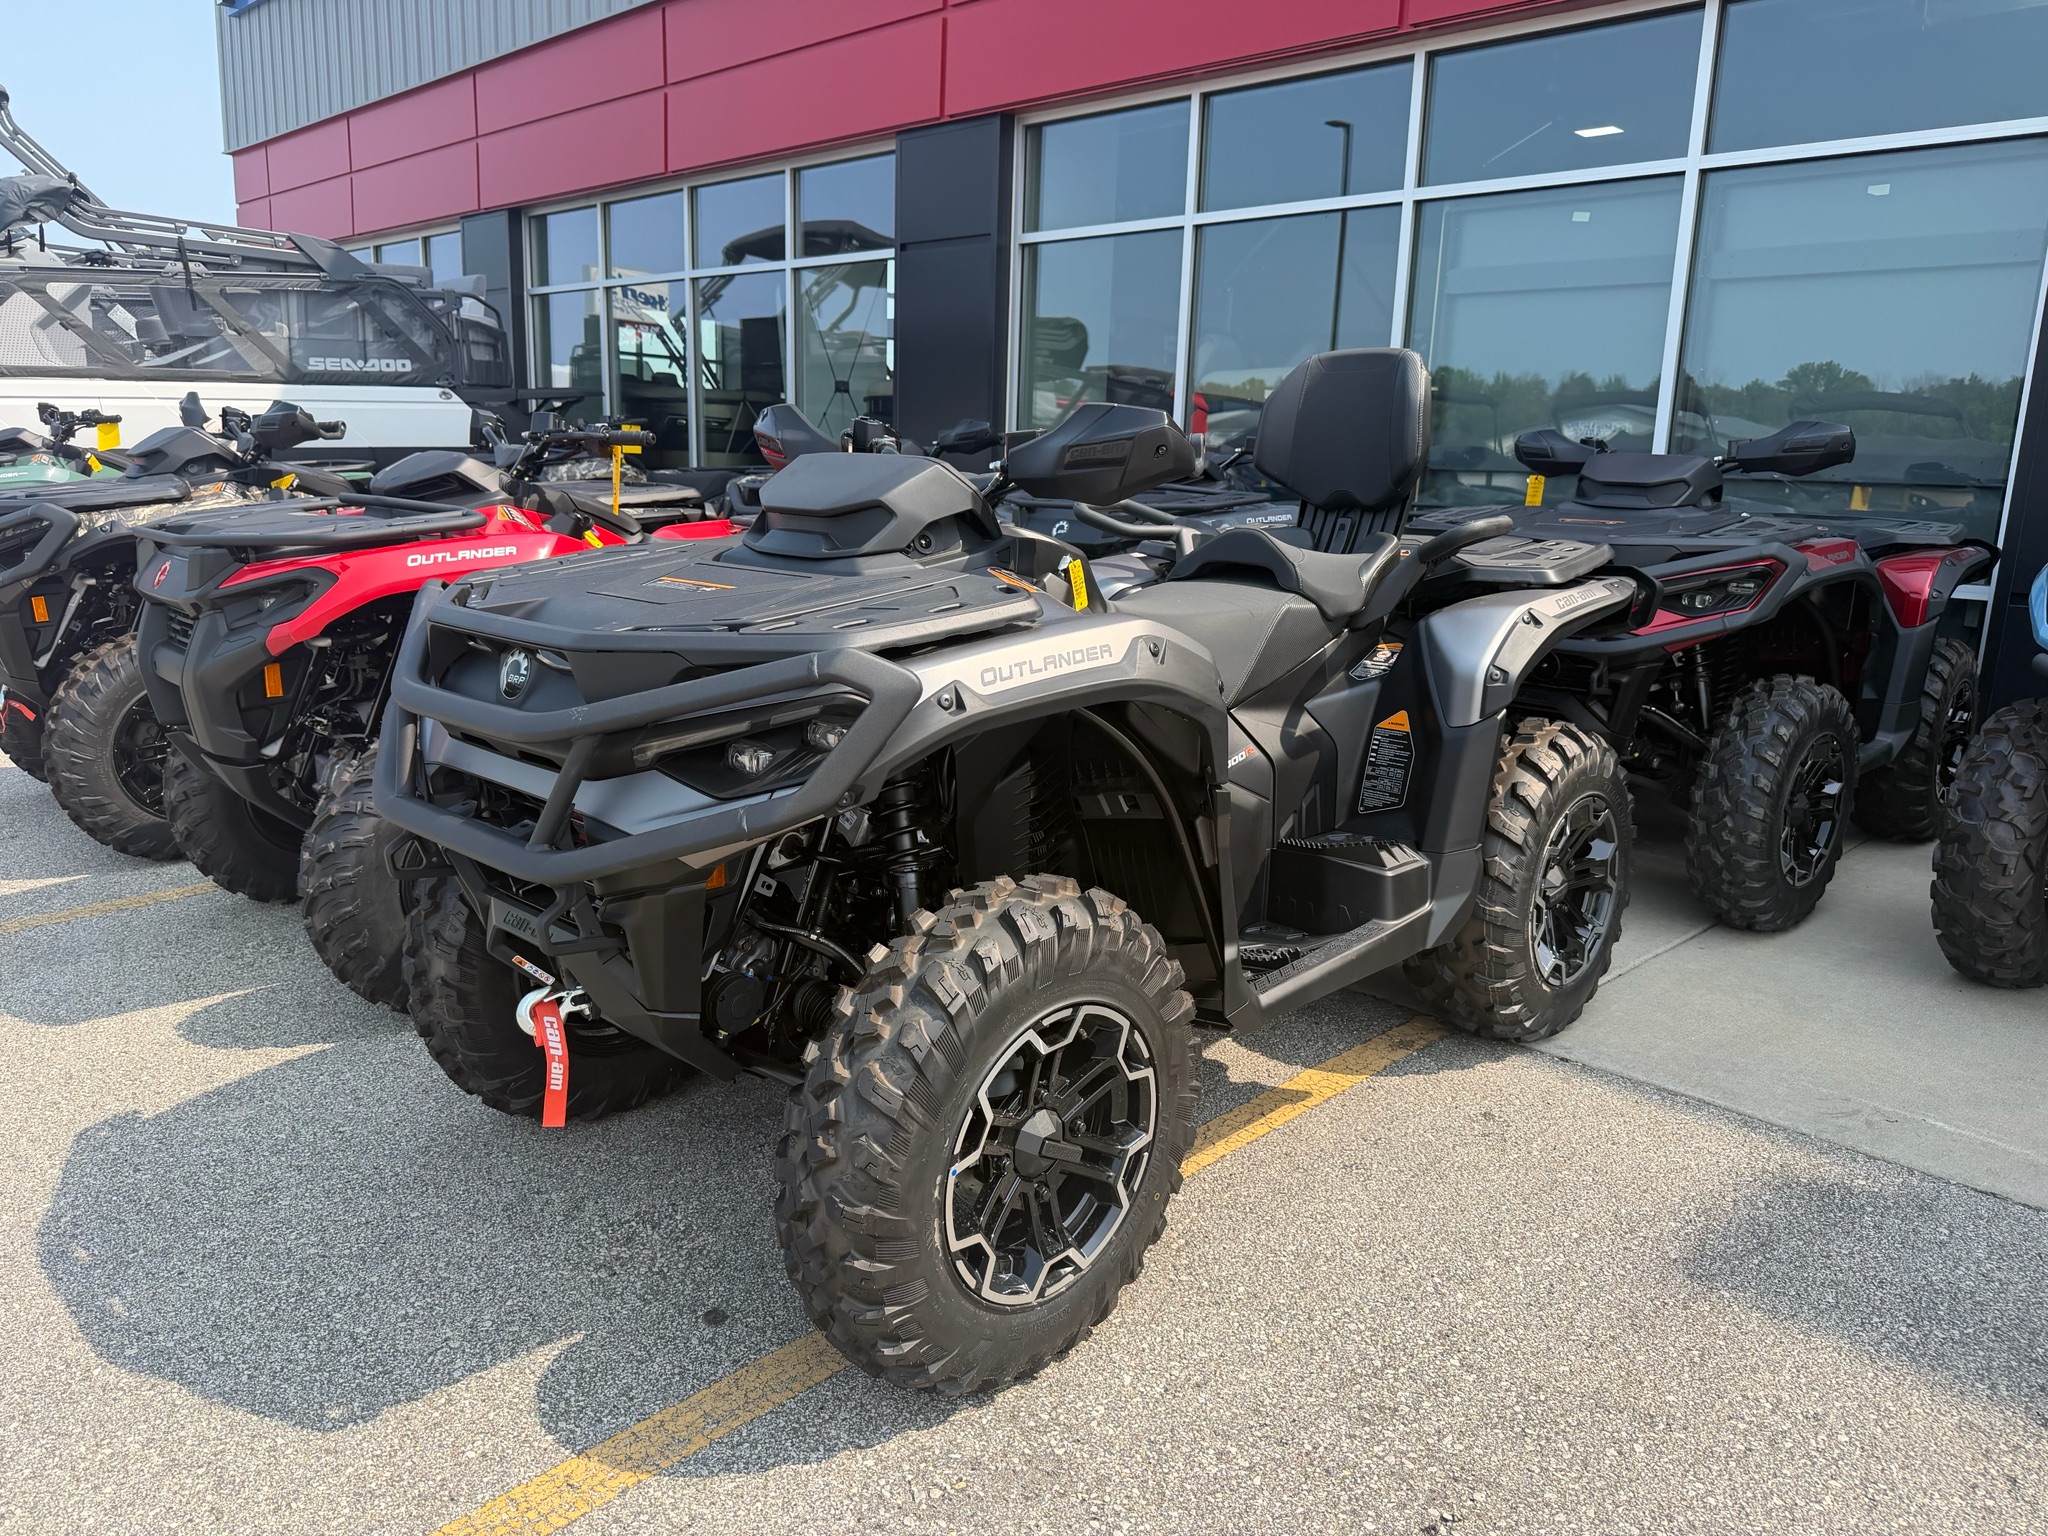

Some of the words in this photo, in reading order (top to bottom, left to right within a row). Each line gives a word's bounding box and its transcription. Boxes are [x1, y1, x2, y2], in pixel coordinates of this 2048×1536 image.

[1246, 514, 1293, 524] OUTLANDER
[407, 545, 517, 567] OUTLANDER
[1555, 589, 1597, 609] can-am
[980, 643, 1113, 687] OUTLANDER
[508, 674, 526, 684] BRP
[543, 1015, 564, 1091] can-am
